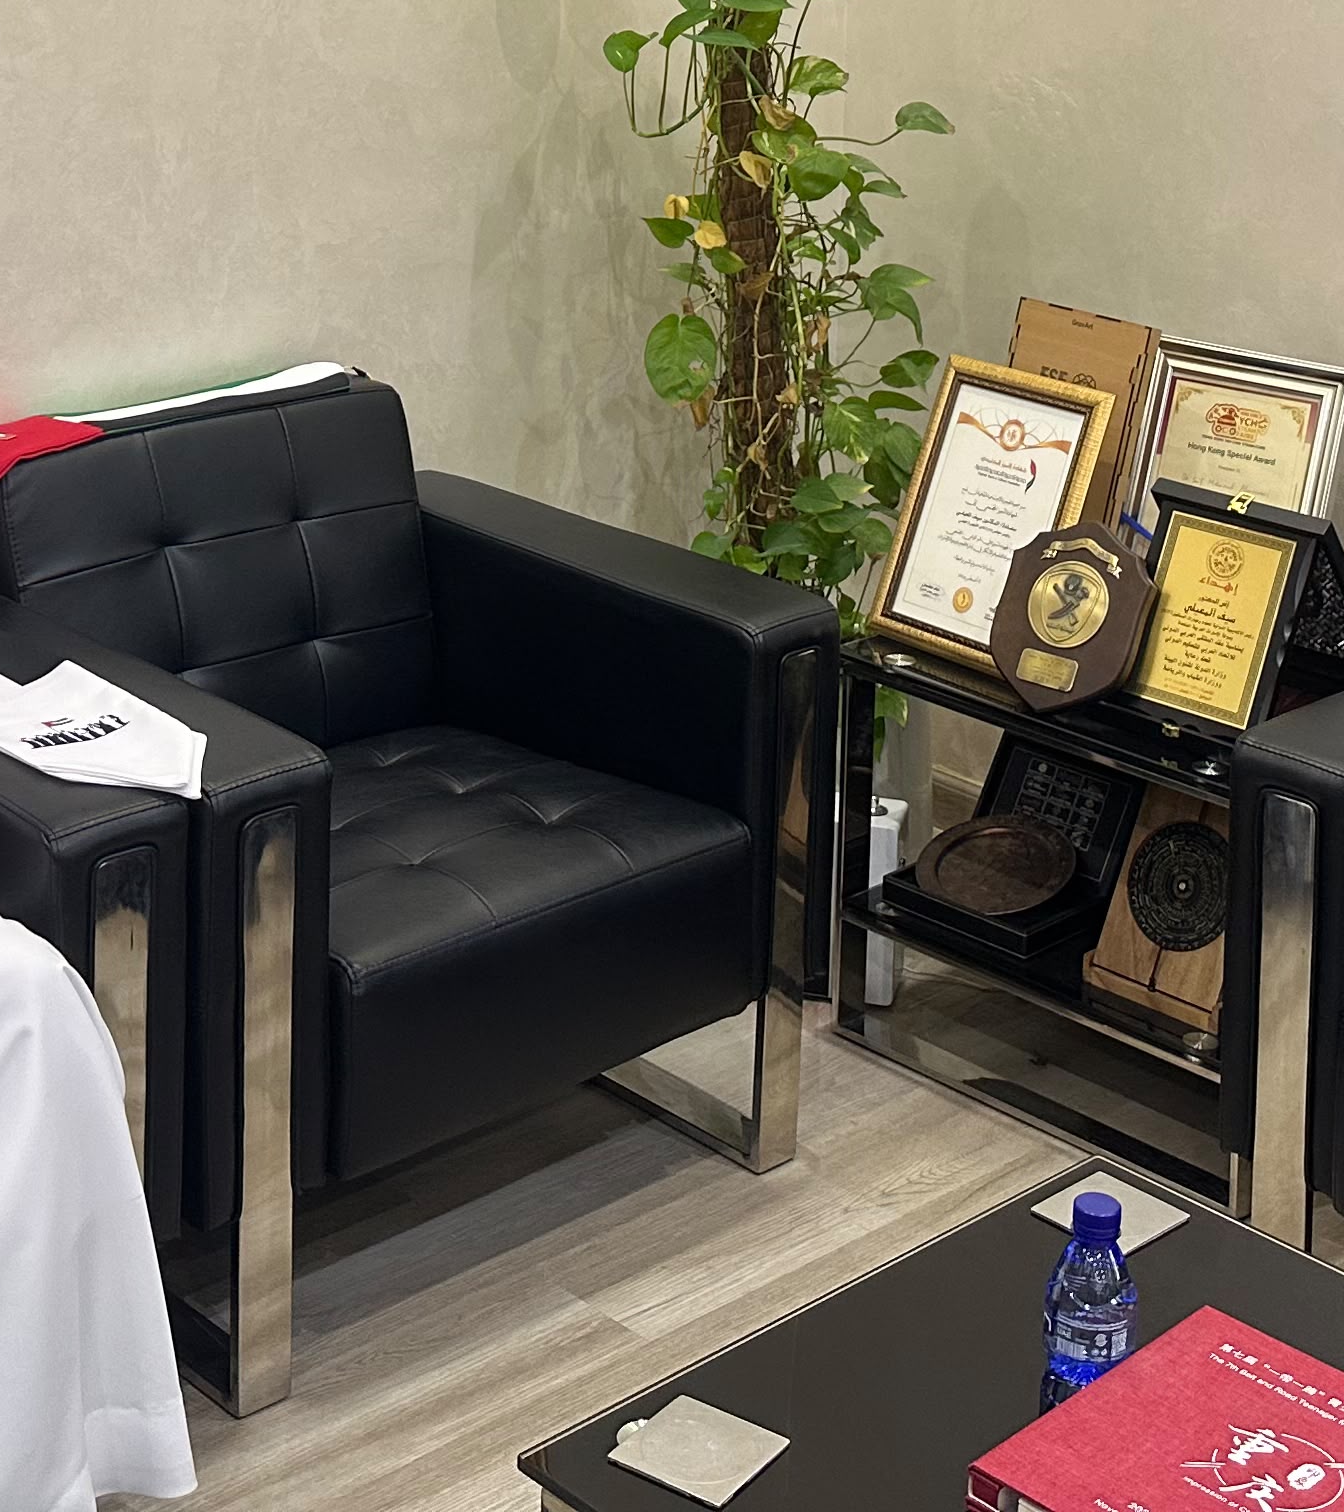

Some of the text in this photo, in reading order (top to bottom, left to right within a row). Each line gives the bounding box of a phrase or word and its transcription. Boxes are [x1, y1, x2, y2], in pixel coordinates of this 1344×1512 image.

[1187, 441, 1206, 453] Hong
[1207, 445, 1225, 457] Kong
[1226, 449, 1252, 462] Special
[1254, 455, 1276, 466] Award
[1209, 1352, 1225, 1364] The
[1257, 1378, 1275, 1389] and
[1274, 1386, 1298, 1401] Road
[1299, 1398, 1338, 1421] Teenager
